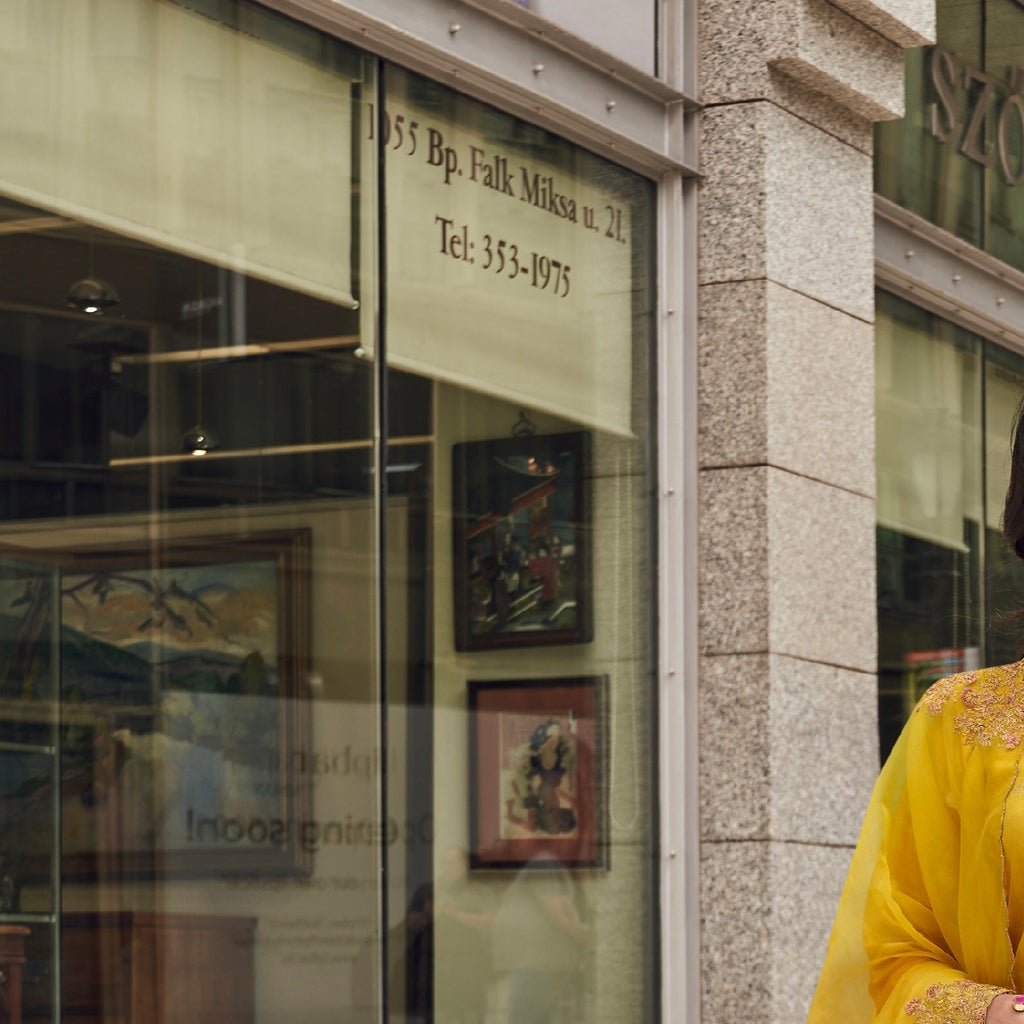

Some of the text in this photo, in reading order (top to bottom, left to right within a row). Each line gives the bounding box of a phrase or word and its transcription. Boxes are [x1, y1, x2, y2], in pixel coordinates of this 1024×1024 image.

[426, 127, 463, 185] Bp.
[469, 145, 515, 197] Falk
[520, 167, 578, 224] Miksa
[583, 205, 600, 232] u.
[605, 205, 627, 244] 21.
[435, 214, 571, 298] Tel: 353-1975
